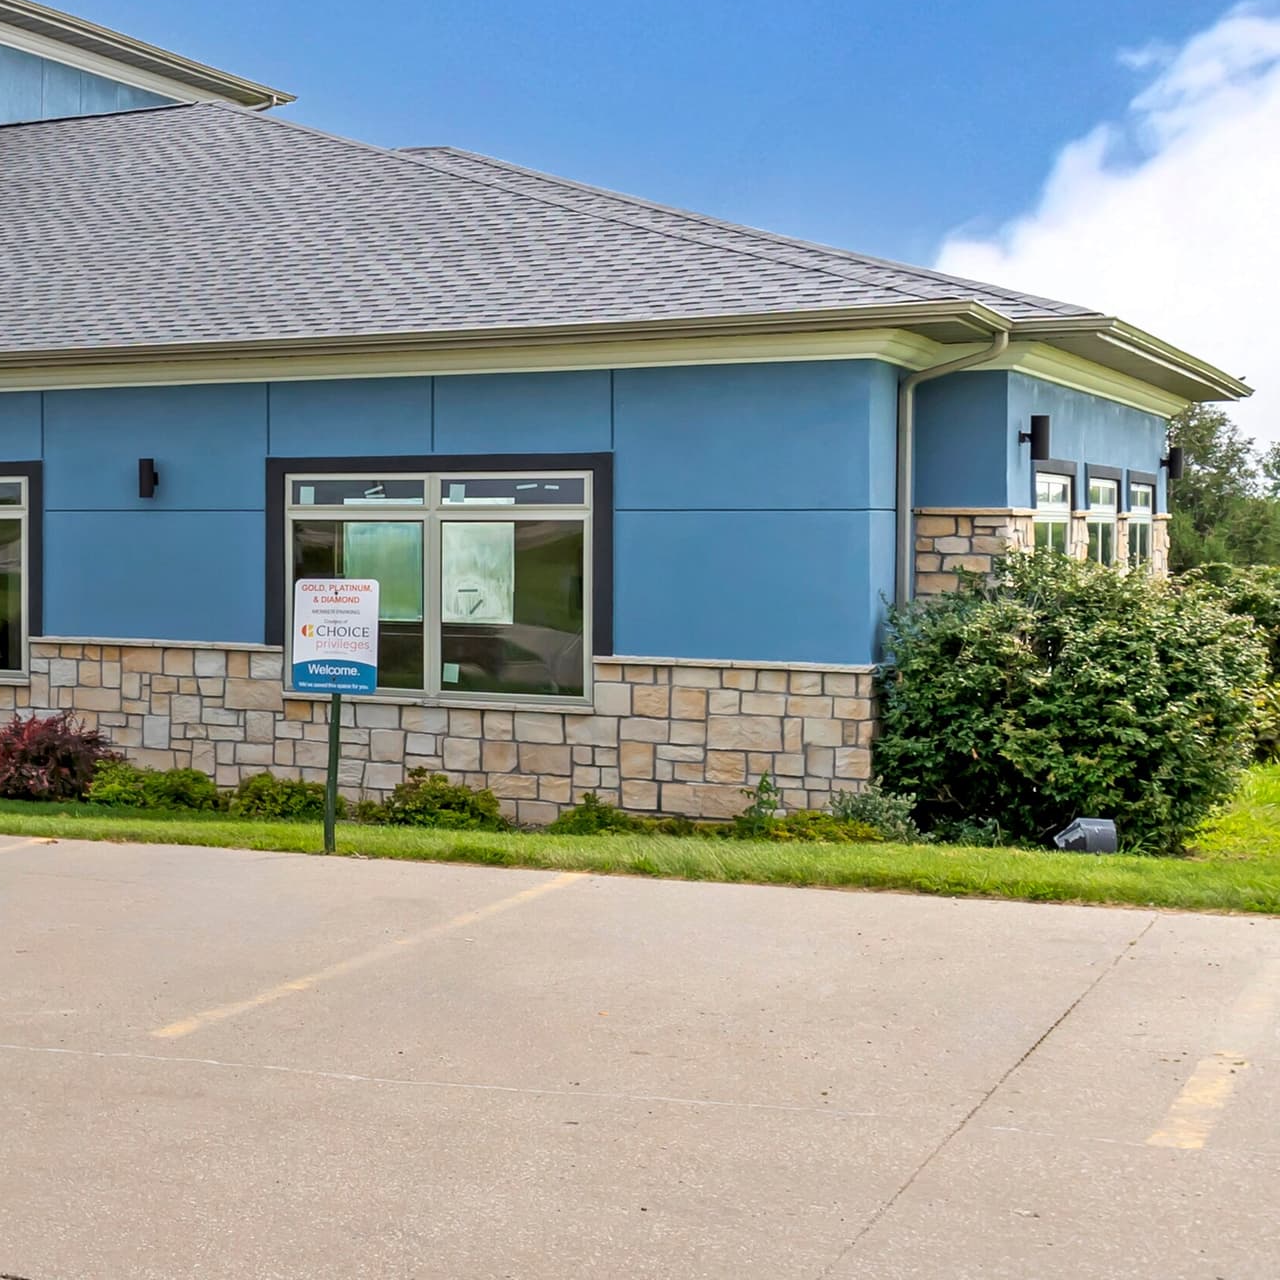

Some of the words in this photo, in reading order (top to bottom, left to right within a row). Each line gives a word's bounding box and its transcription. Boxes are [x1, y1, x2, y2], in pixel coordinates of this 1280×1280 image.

[321, 596, 360, 604] DIAMOND
[316, 625, 370, 638] CHOICE
[315, 638, 370, 652] privileges
[307, 663, 361, 677] Welcome.
